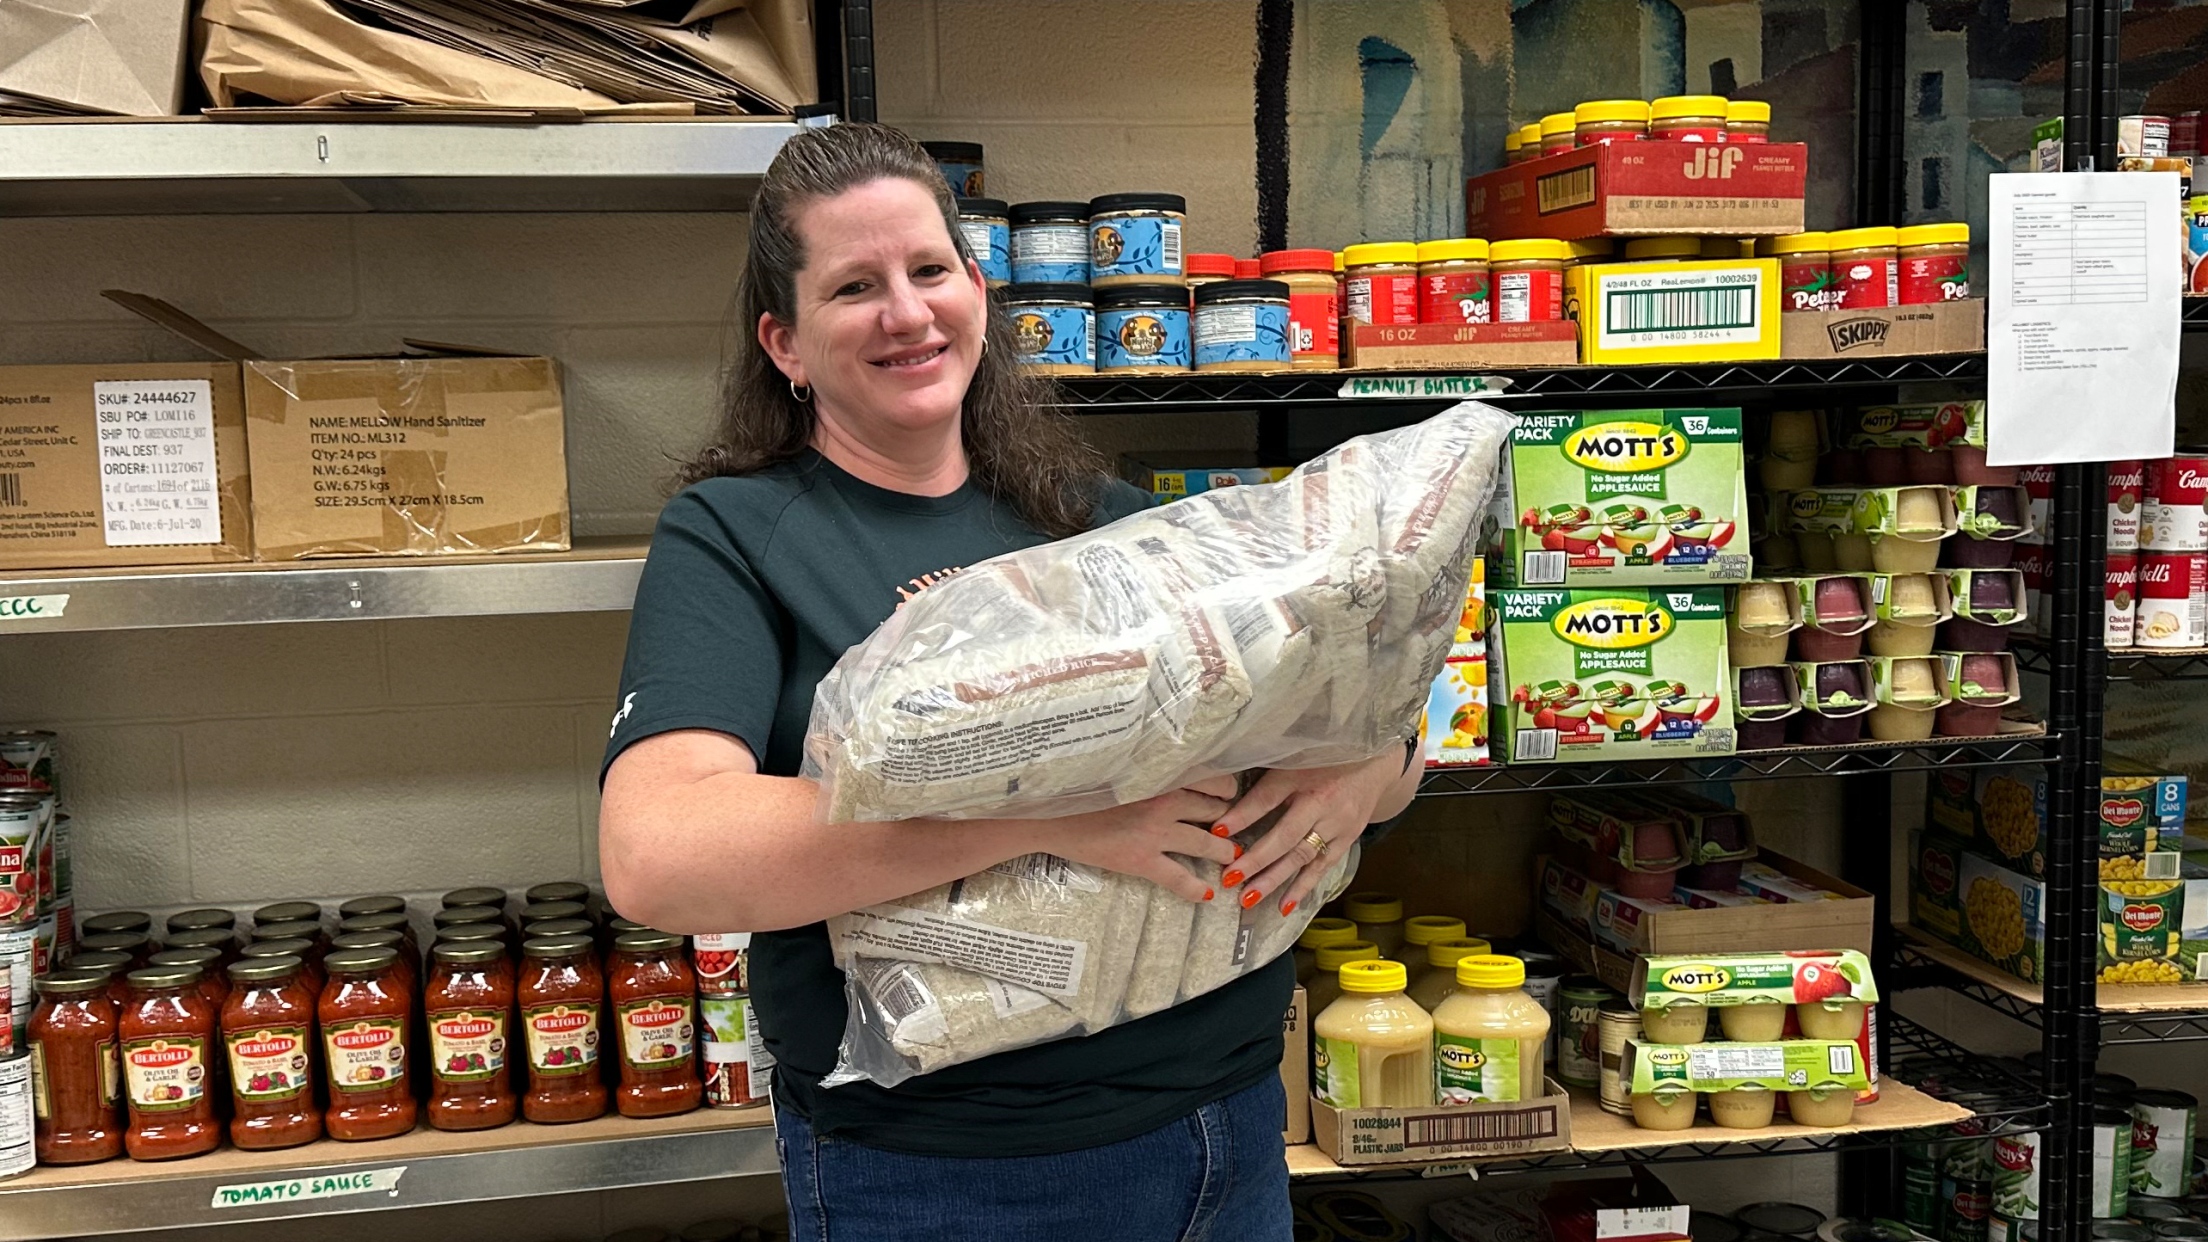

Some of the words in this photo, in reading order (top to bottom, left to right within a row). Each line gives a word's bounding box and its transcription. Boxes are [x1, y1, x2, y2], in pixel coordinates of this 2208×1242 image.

[1683, 146, 1743, 180] Jif
[1641, 279, 1652, 288] OZ
[1380, 329, 1394, 341] 16
[1397, 329, 1416, 340] OZ
[1454, 327, 1478, 342] Jif
[1838, 322, 1889, 347] SKIPPY
[1354, 378, 1416, 395] PEANUT
[98, 393, 131, 405] SKU#:
[133, 392, 196, 405] 24444627
[100, 411, 121, 423] SBU
[309, 416, 348, 428] NAME:
[350, 416, 401, 428] MELLOW
[404, 416, 434, 427] Hand
[437, 416, 486, 427] Sanitizer
[1863, 412, 1896, 427] MOTT'S
[4, 425, 42, 434] AMERICA
[45, 425, 59, 434] INC
[1688, 419, 1704, 431] 36
[101, 428, 123, 440] SHIP
[311, 433, 339, 443] ITEM
[367, 433, 406, 443] ML312
[1514, 428, 1553, 441] PACK
[104, 445, 131, 457] FINAL
[163, 444, 183, 456] 937
[1576, 436, 1675, 457] MOTT'S
[8, 449, 25, 458] USA
[340, 449, 354, 460] 24
[357, 452, 376, 462] pcs
[104, 463, 150, 475] ORDER#:
[151, 462, 204, 474] 11127067
[342, 464, 386, 477] 6.24kgs
[343, 480, 367, 491] 6.75
[369, 479, 390, 492] kgs
[1158, 477, 1170, 491] 16
[1605, 475, 1627, 484] Sugar
[1630, 474, 1660, 482] Added
[1591, 483, 1660, 493] APPLESAUCE
[344, 495, 386, 506] 29.5cm
[388, 495, 396, 506] X
[399, 495, 431, 506] 27cm
[432, 494, 441, 505] X
[444, 494, 484, 505] 18.5cm
[157, 518, 201, 531] 6-Jul-20
[1629, 557, 1649, 565] APPLE
[1504, 593, 1564, 605] VARIETY
[1673, 597, 1689, 608] 36
[1505, 606, 1543, 618] PACK
[1691, 603, 1720, 612] Containers
[1565, 613, 1661, 635] MOTT'S
[1580, 651, 1592, 659] No
[1593, 651, 1617, 661] Sugar
[1619, 650, 1646, 659] Added
[1580, 660, 1647, 669] APPLESAUCE
[2164, 784, 2178, 801] 8
[2103, 805, 2116, 816] Del
[2117, 804, 2141, 816] Monte
[2161, 803, 2181, 812] CANS
[2125, 911, 2137, 920] Del
[2138, 910, 2161, 921] Monte
[1747, 966, 1765, 974] Sugar
[1669, 972, 1724, 985] MOTT'S
[536, 1016, 587, 1030] BERTOLLI
[631, 1011, 682, 1025] BERTOLLI
[440, 1022, 492, 1036] BERTOLLI
[336, 1032, 391, 1047] BERTOLLI
[238, 1040, 293, 1055] BERTOLLI
[134, 1049, 189, 1064] BERTOLLI
[1440, 1050, 1480, 1064] MOTT'S
[1353, 1144, 1383, 1154] PLASTIC
[1384, 1143, 1404, 1153] JARS
[1460, 1143, 1488, 1152] 14800
[1494, 1142, 1523, 1150] 00190
[221, 1181, 301, 1204] TOMATO
[310, 1173, 374, 1194] SAUCE
